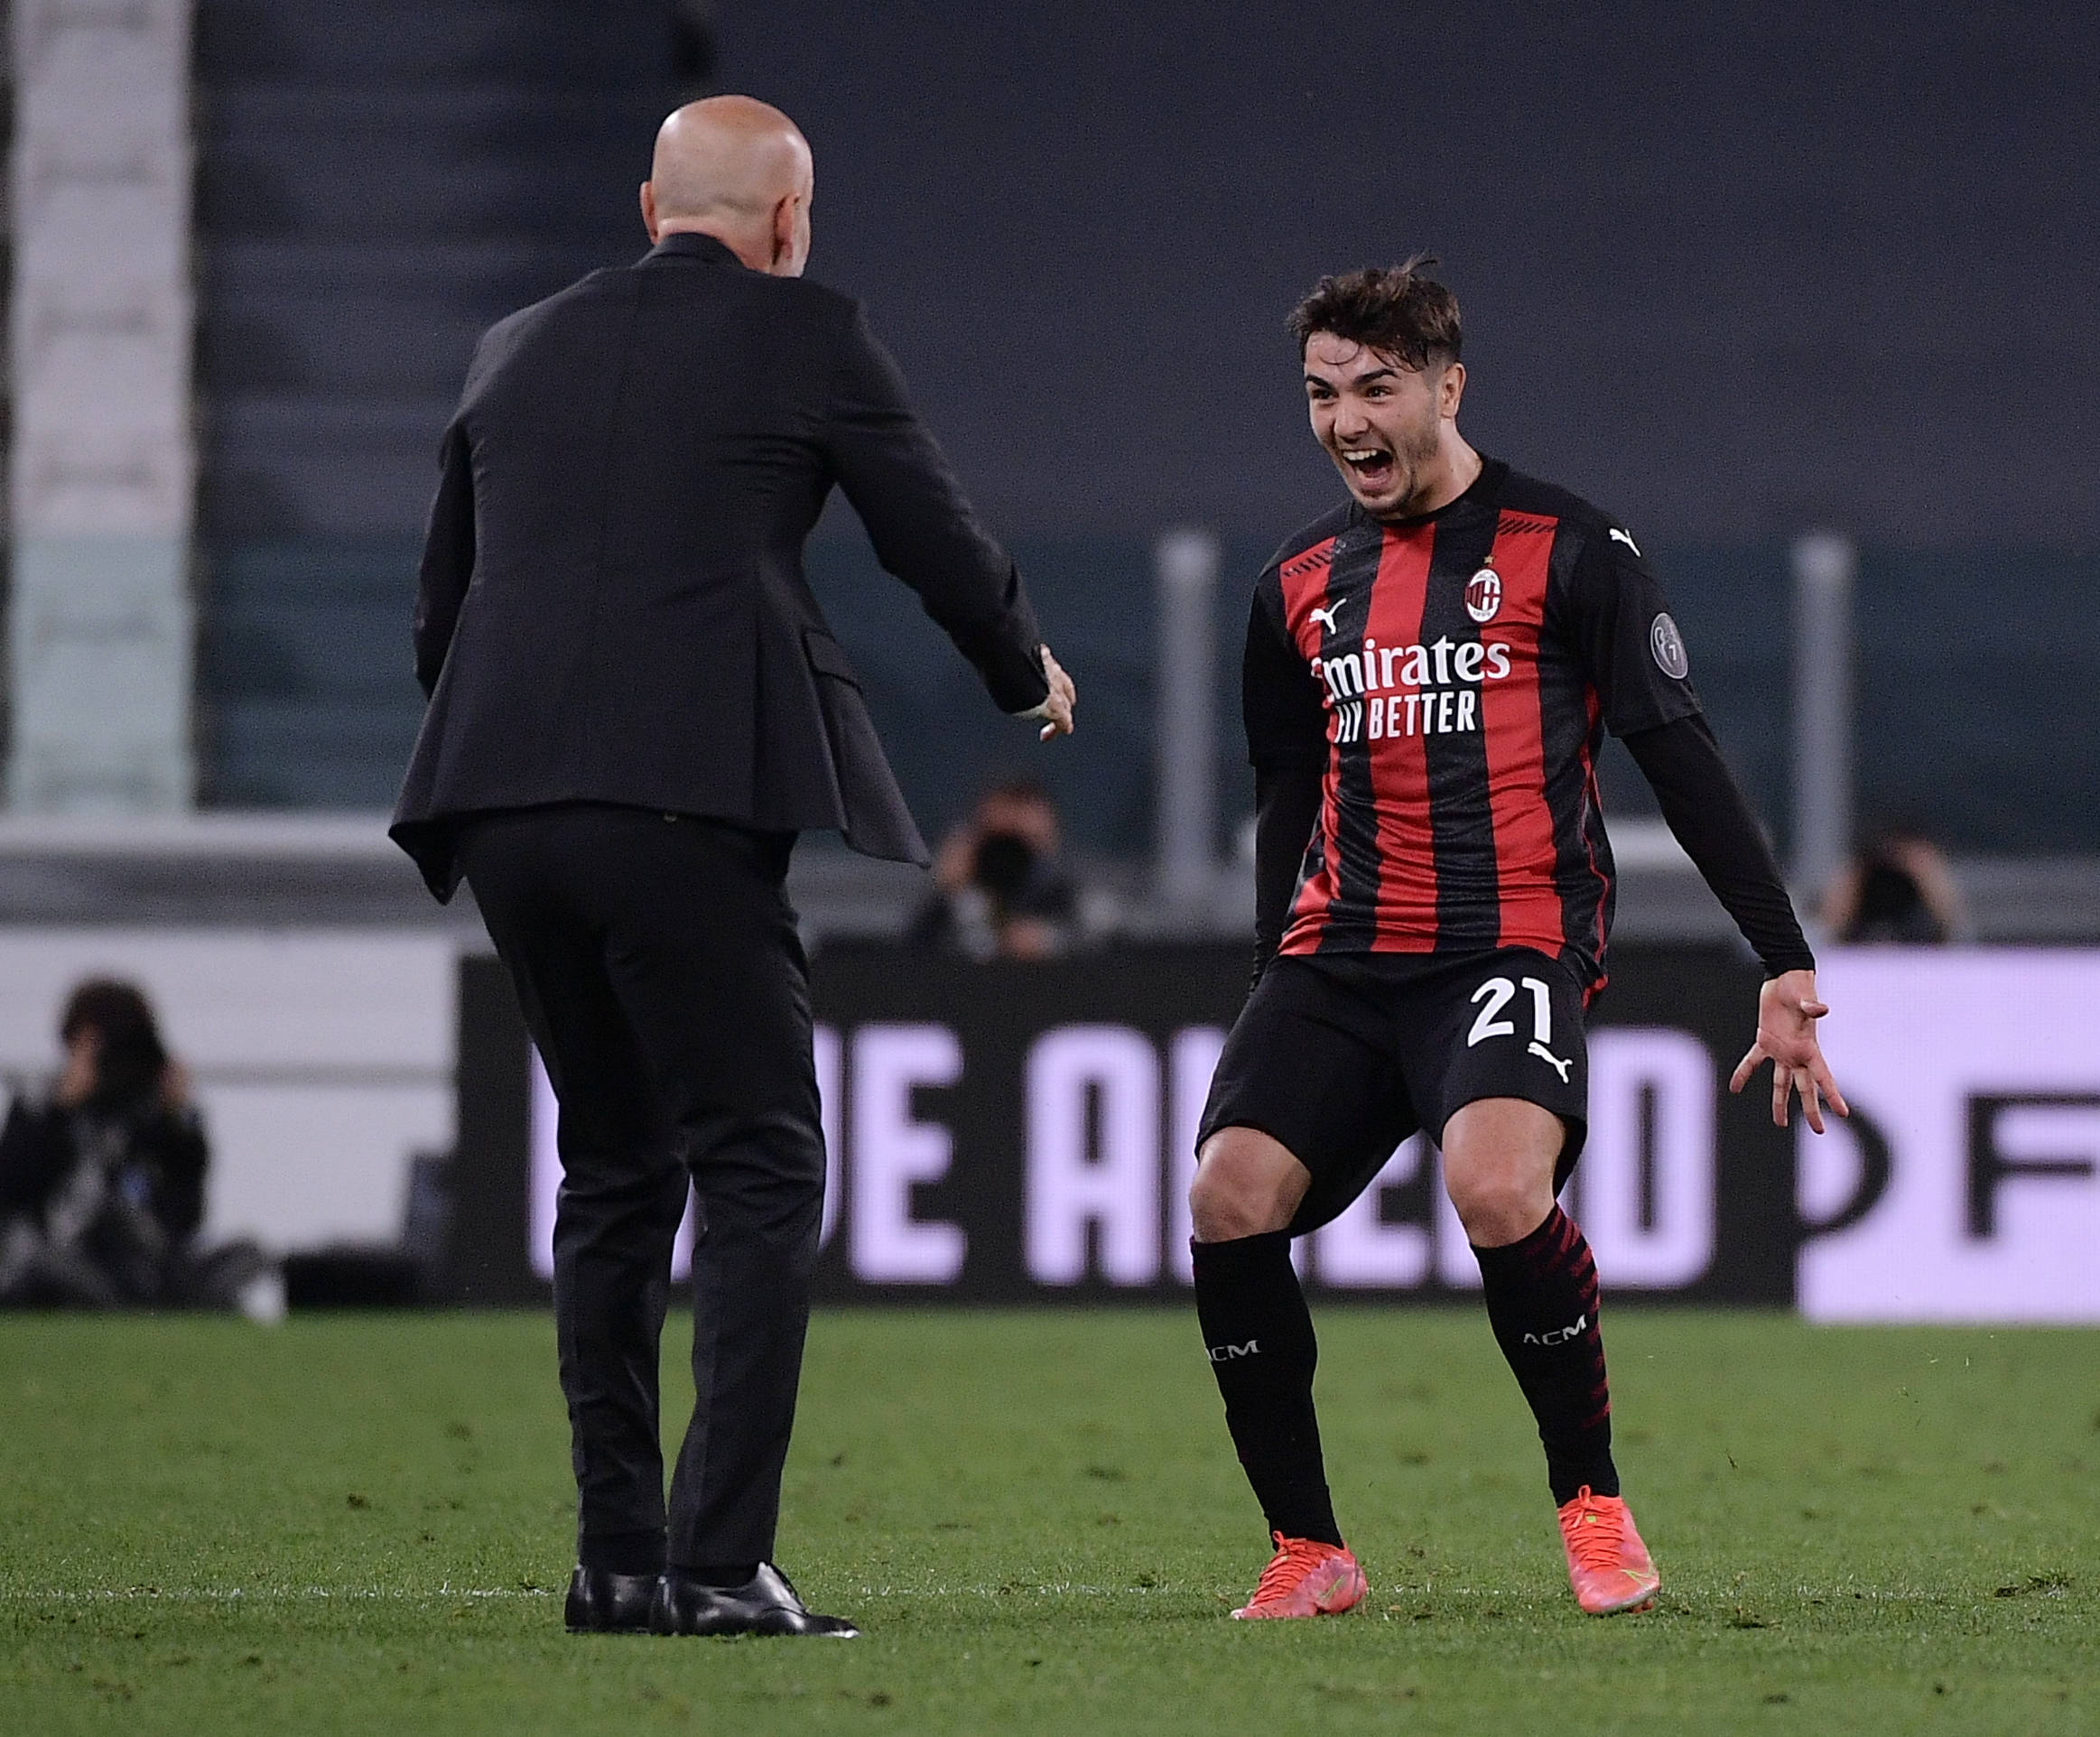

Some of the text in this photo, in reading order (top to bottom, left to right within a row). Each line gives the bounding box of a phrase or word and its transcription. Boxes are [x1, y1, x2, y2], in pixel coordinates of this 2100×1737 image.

[1368, 690, 1475, 740] BETTER
[1467, 977, 1551, 1047] 21
[1206, 1340, 1261, 1361] CM
[1523, 1314, 1587, 1346] ACM
